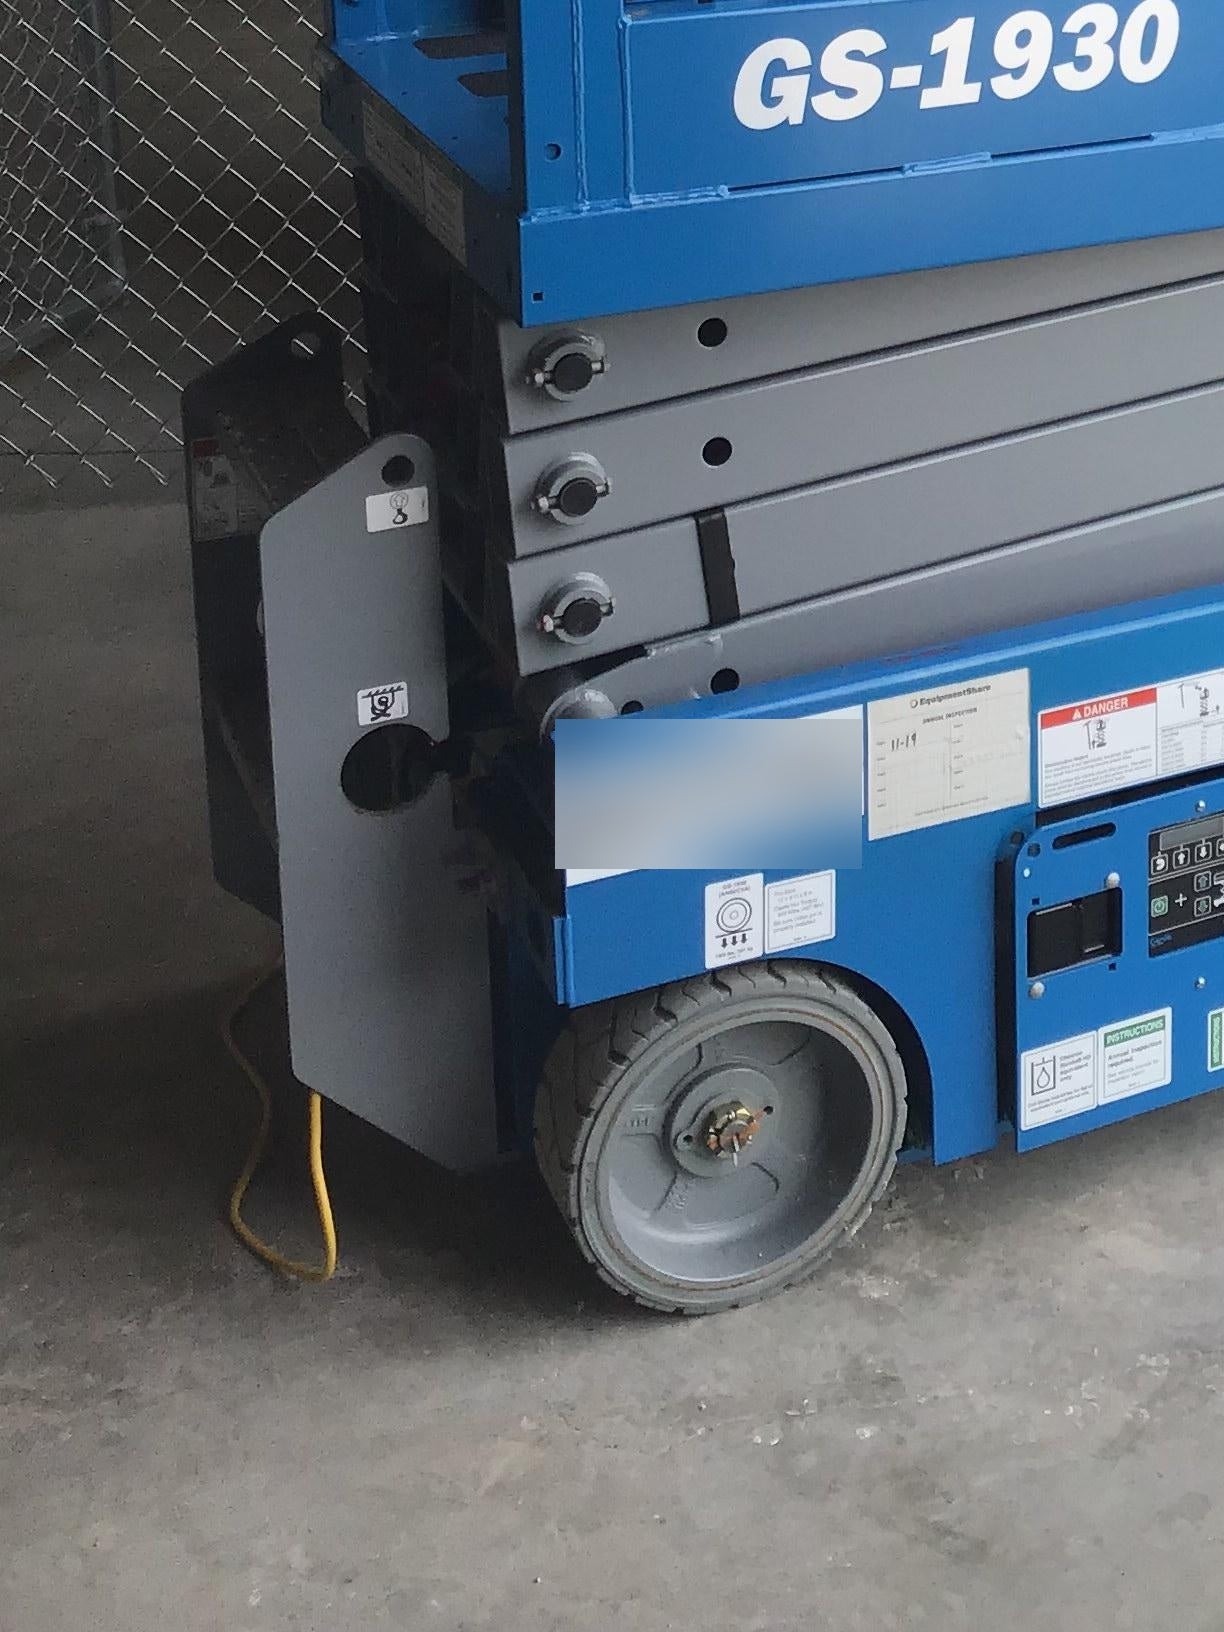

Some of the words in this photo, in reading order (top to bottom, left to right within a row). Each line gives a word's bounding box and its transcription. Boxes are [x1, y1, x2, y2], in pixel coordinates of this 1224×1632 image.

[920, 684, 992, 706] EquipmentShare
[1083, 697, 1129, 718] DANGER
[1106, 1020, 1164, 1045] INSTRUCTIONS
